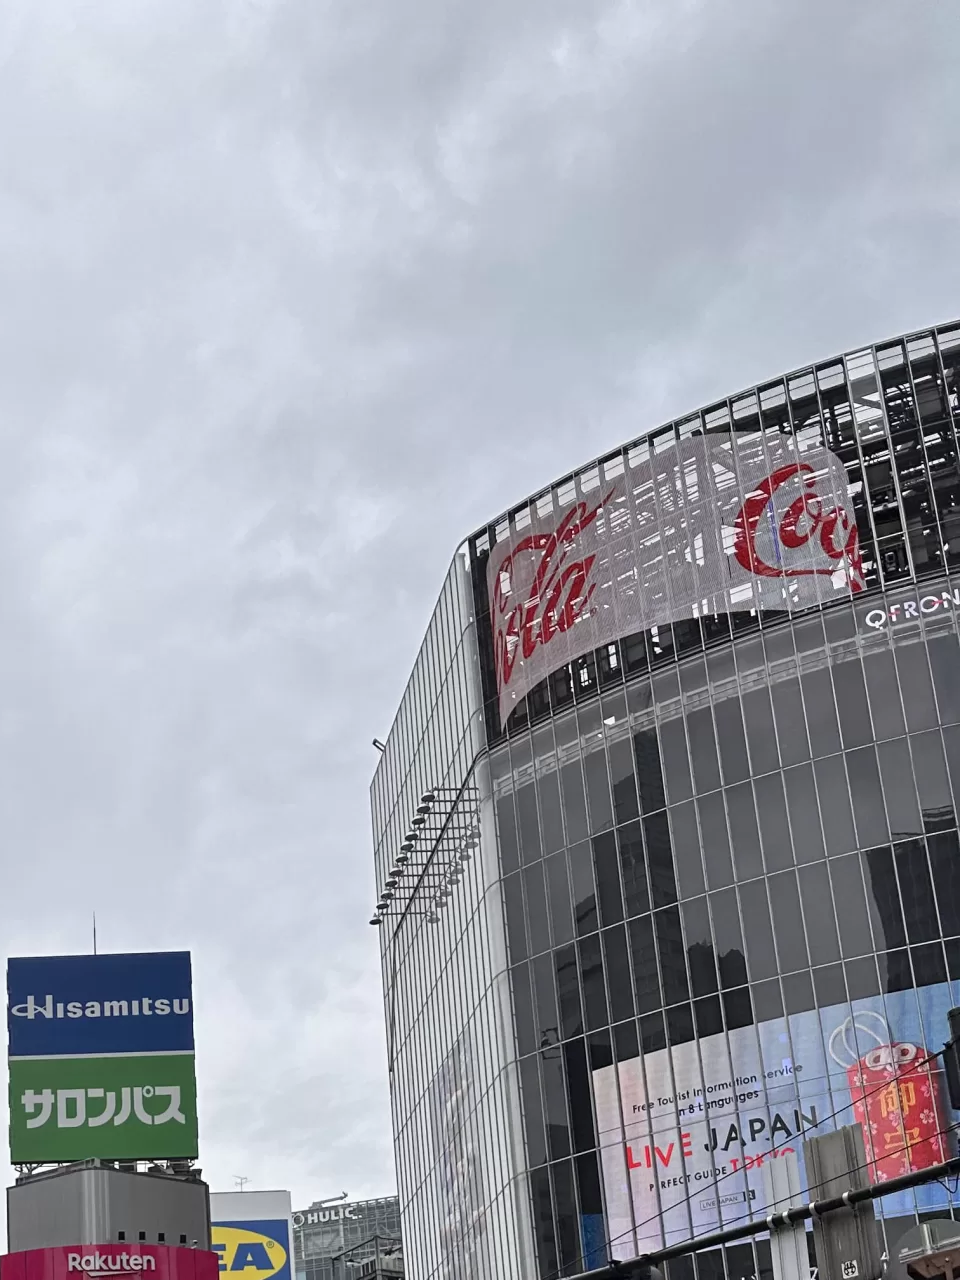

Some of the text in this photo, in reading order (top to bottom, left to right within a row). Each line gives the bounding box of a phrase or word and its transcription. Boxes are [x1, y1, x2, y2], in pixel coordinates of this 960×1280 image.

[10, 994, 190, 1019] Hisamitsu
[657, 1091, 690, 1108] Touist
[693, 1074, 757, 1098] Inormtion
[763, 1064, 803, 1079] ervice
[21, 1085, 187, 1128] サロンパス
[688, 1103, 695, 1113] 8
[627, 1105, 819, 1170] LIVE JAPAN
[649, 1174, 691, 1192] PRFECT
[730, 1147, 795, 1172] TOK
[307, 1206, 354, 1225] HULIC
[67, 1252, 156, 1272] Rakuten
